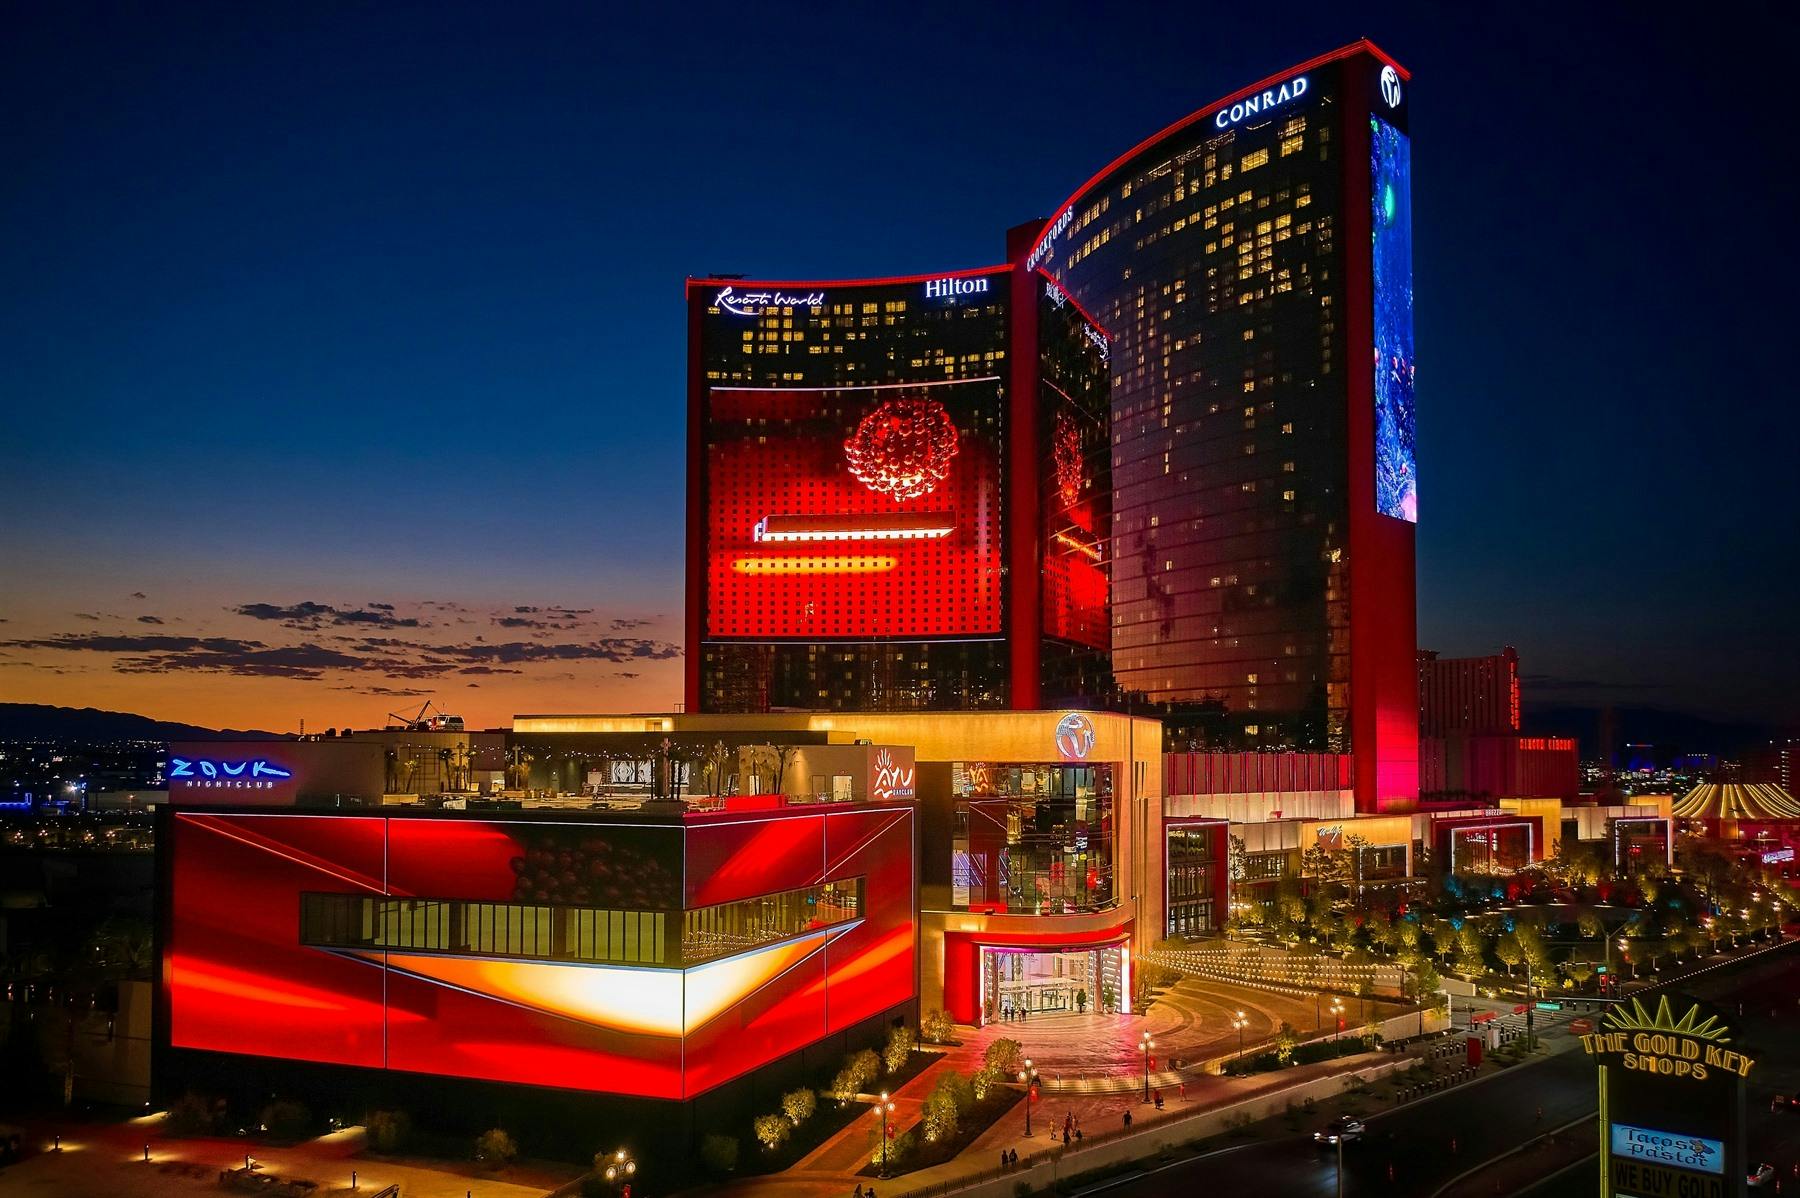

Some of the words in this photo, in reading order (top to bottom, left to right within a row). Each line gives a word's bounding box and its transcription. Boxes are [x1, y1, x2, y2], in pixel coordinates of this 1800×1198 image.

[1215, 77, 1308, 128] CONRAD
[1026, 205, 1074, 272] CROCKFORDS
[714, 286, 772, 316] Resorts
[775, 291, 825, 306] World
[925, 277, 989, 298] Hilton
[170, 759, 291, 778] ZOUK
[186, 780, 274, 788] NIGHTCLUB
[1579, 1032, 1628, 1054] THE
[1633, 1032, 1701, 1059] GOLD
[1705, 1044, 1756, 1078] KEY
[1623, 1052, 1709, 1081] SHOPS
[1621, 1126, 1688, 1150] Tacos
[1625, 1142, 1709, 1167] Pastor
[1615, 1162, 1638, 1188] WE
[1642, 1168, 1672, 1194] BUY
[1678, 1174, 1721, 1198] GOLD
